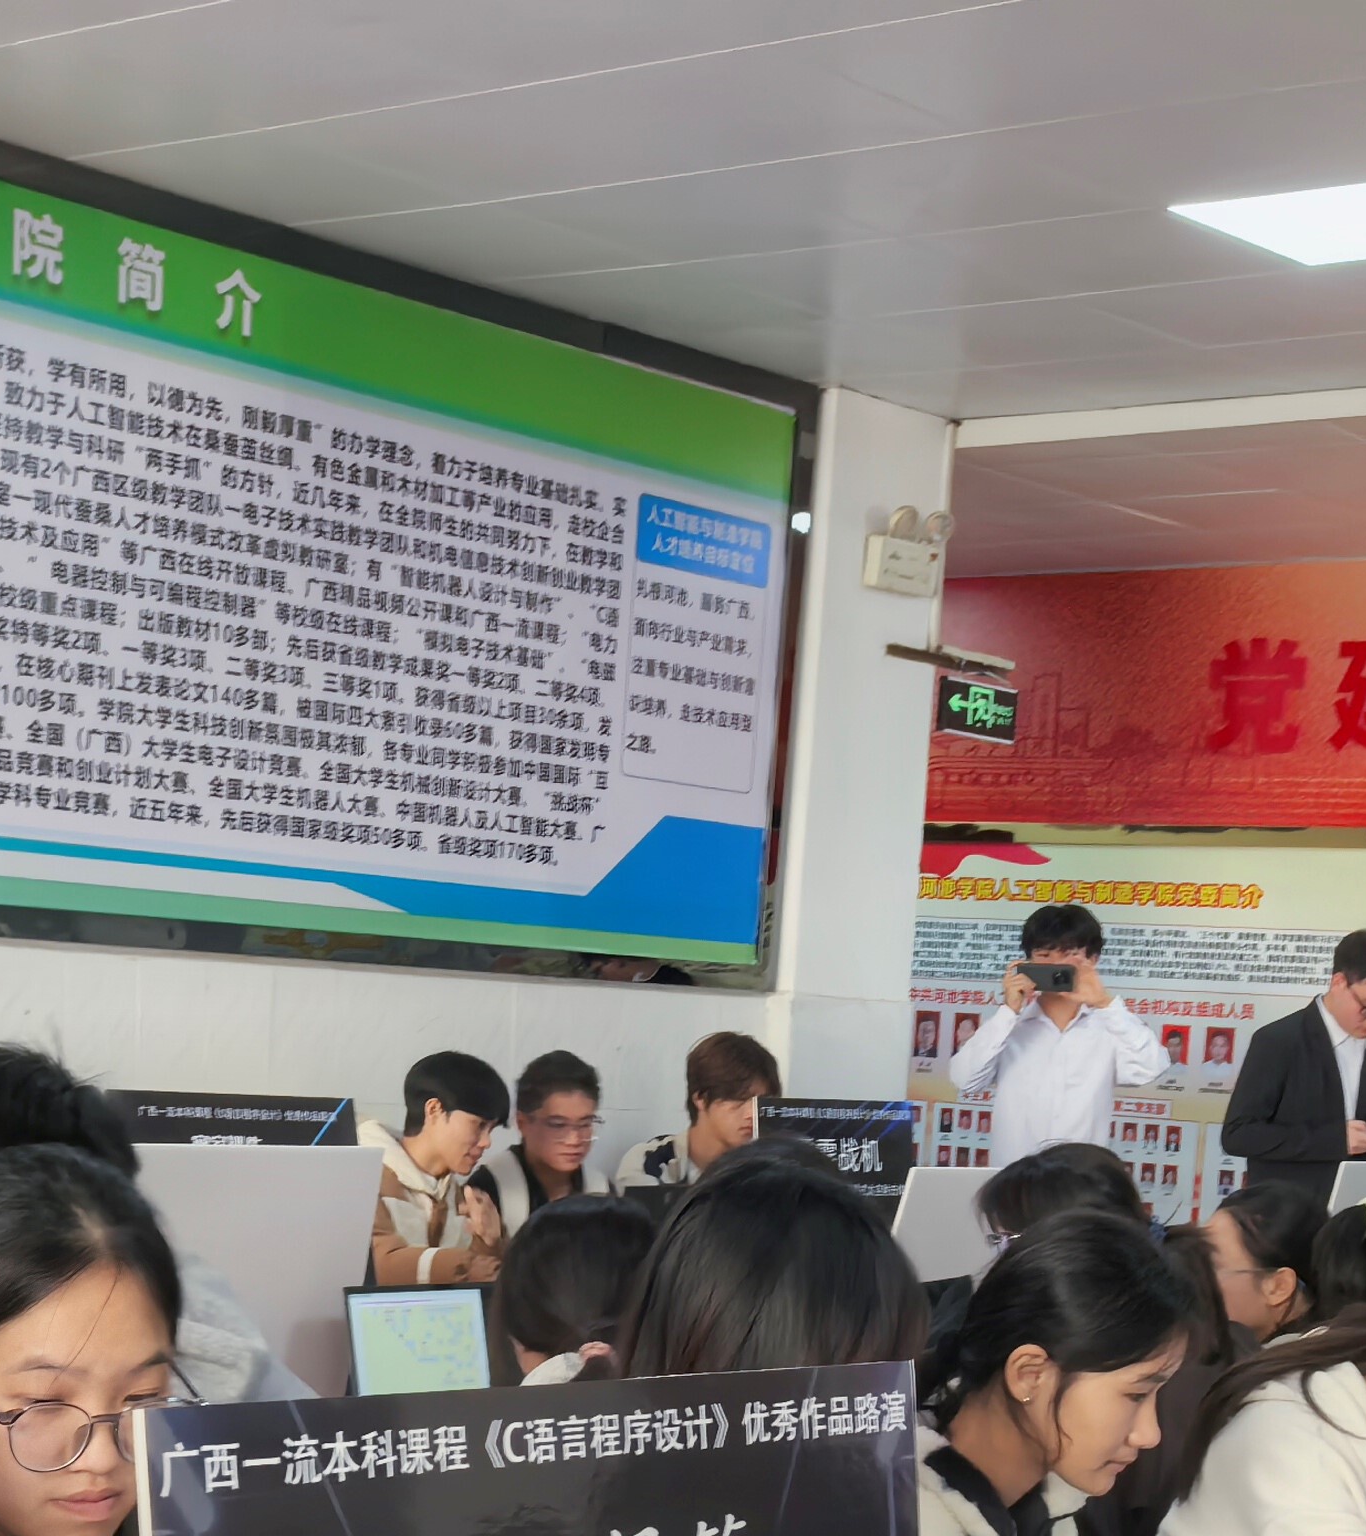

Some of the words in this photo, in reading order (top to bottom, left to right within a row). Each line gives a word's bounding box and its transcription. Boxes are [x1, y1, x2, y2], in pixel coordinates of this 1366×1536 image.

[160, 1391, 907, 1498] 广西一流本科课程《C语言程序设计》优秀作品路演
